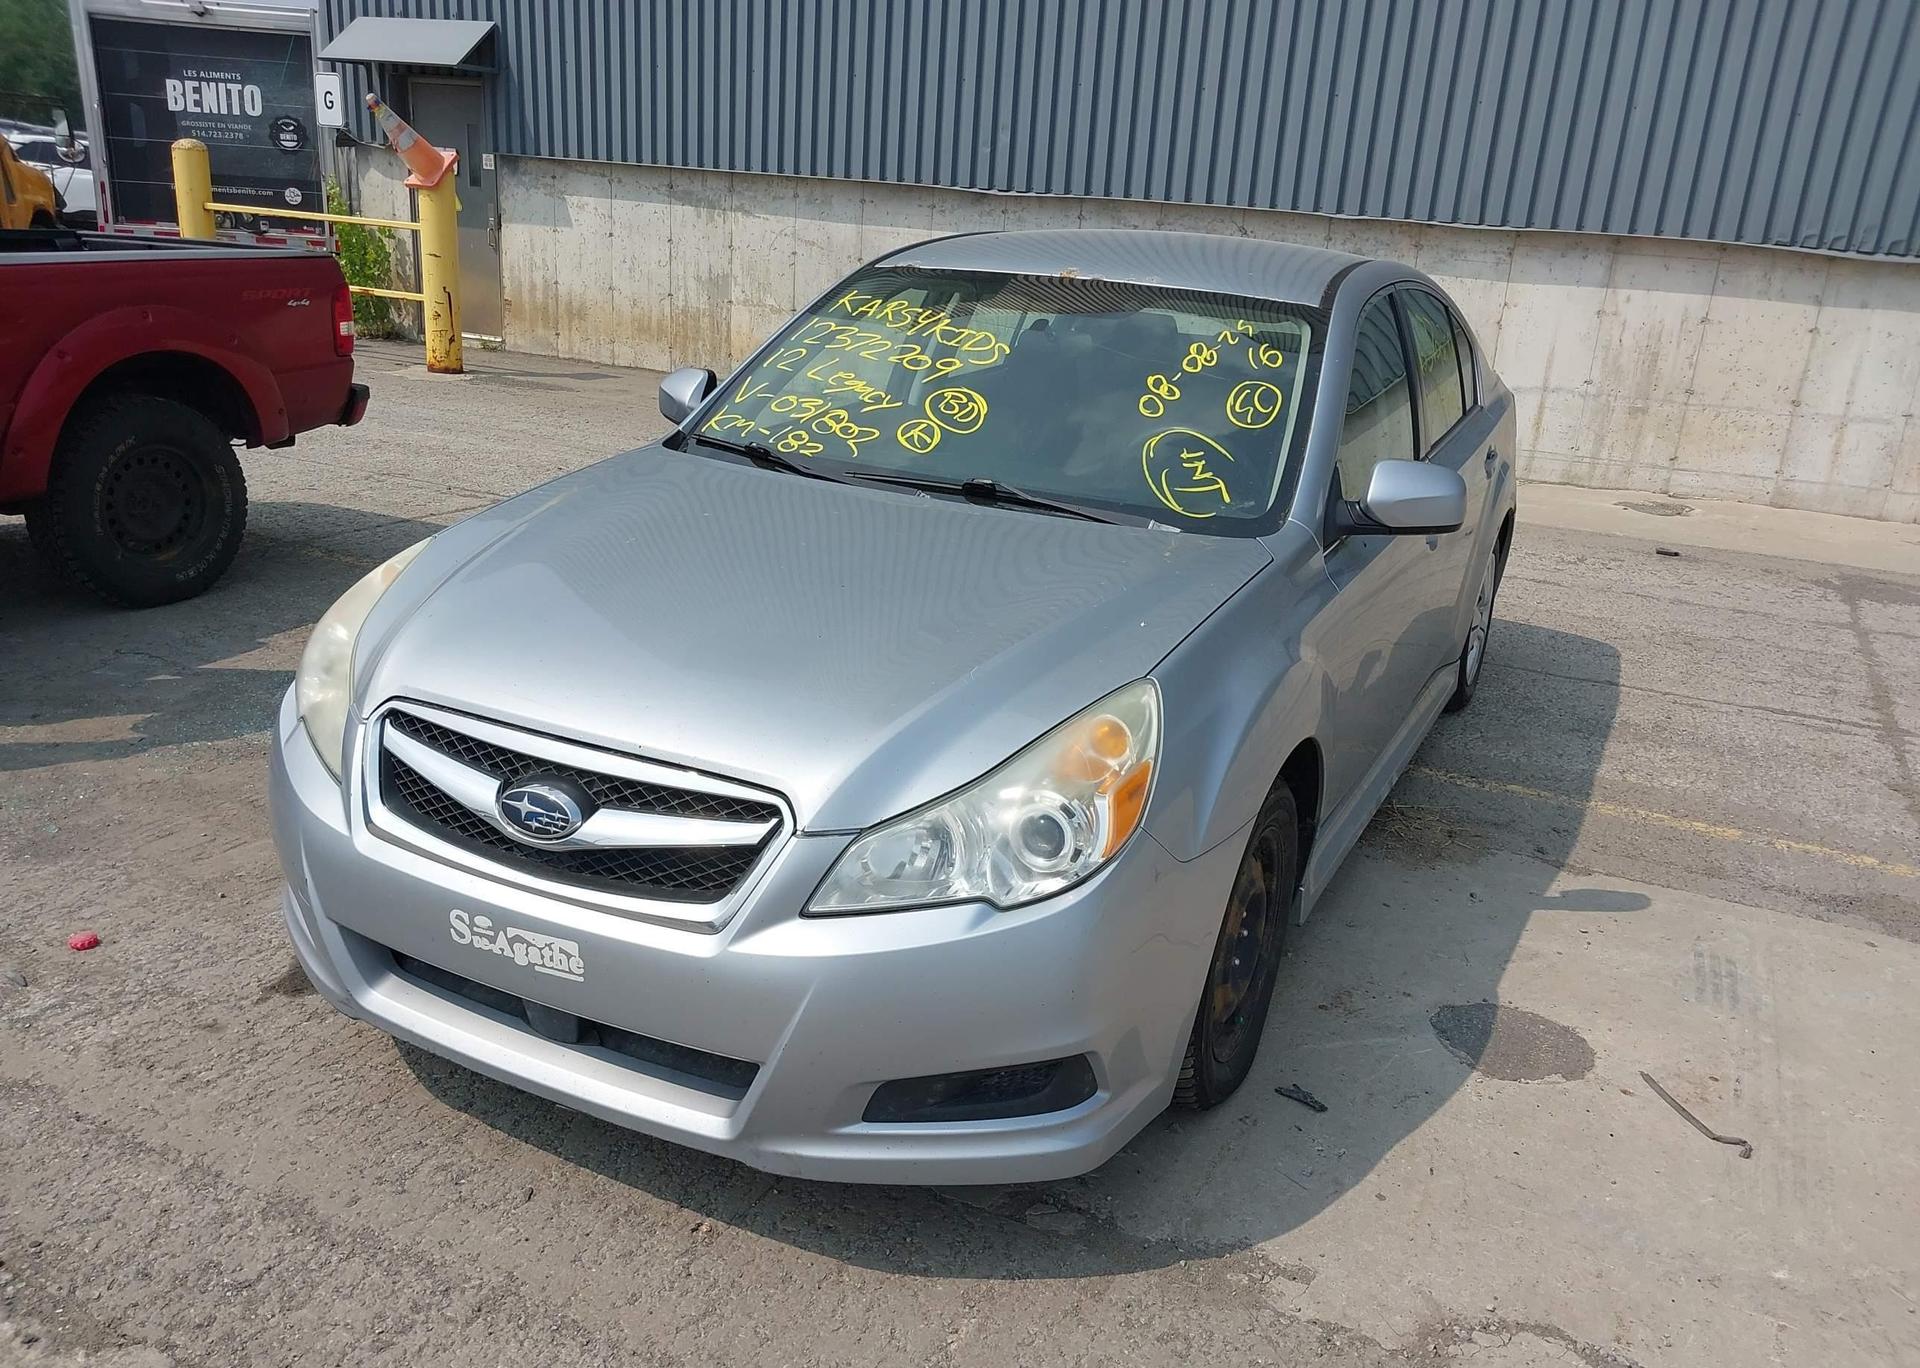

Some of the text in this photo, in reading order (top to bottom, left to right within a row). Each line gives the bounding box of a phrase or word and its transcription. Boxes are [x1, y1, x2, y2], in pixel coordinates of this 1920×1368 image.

[183, 69, 242, 80] LES ALIMENTS
[165, 78, 263, 117] BENITO
[323, 90, 335, 110] G
[180, 120, 216, 129] GROSSISTE
[227, 122, 253, 131] VIANDE
[762, 348, 808, 372] 12
[1248, 343, 1283, 370] 16
